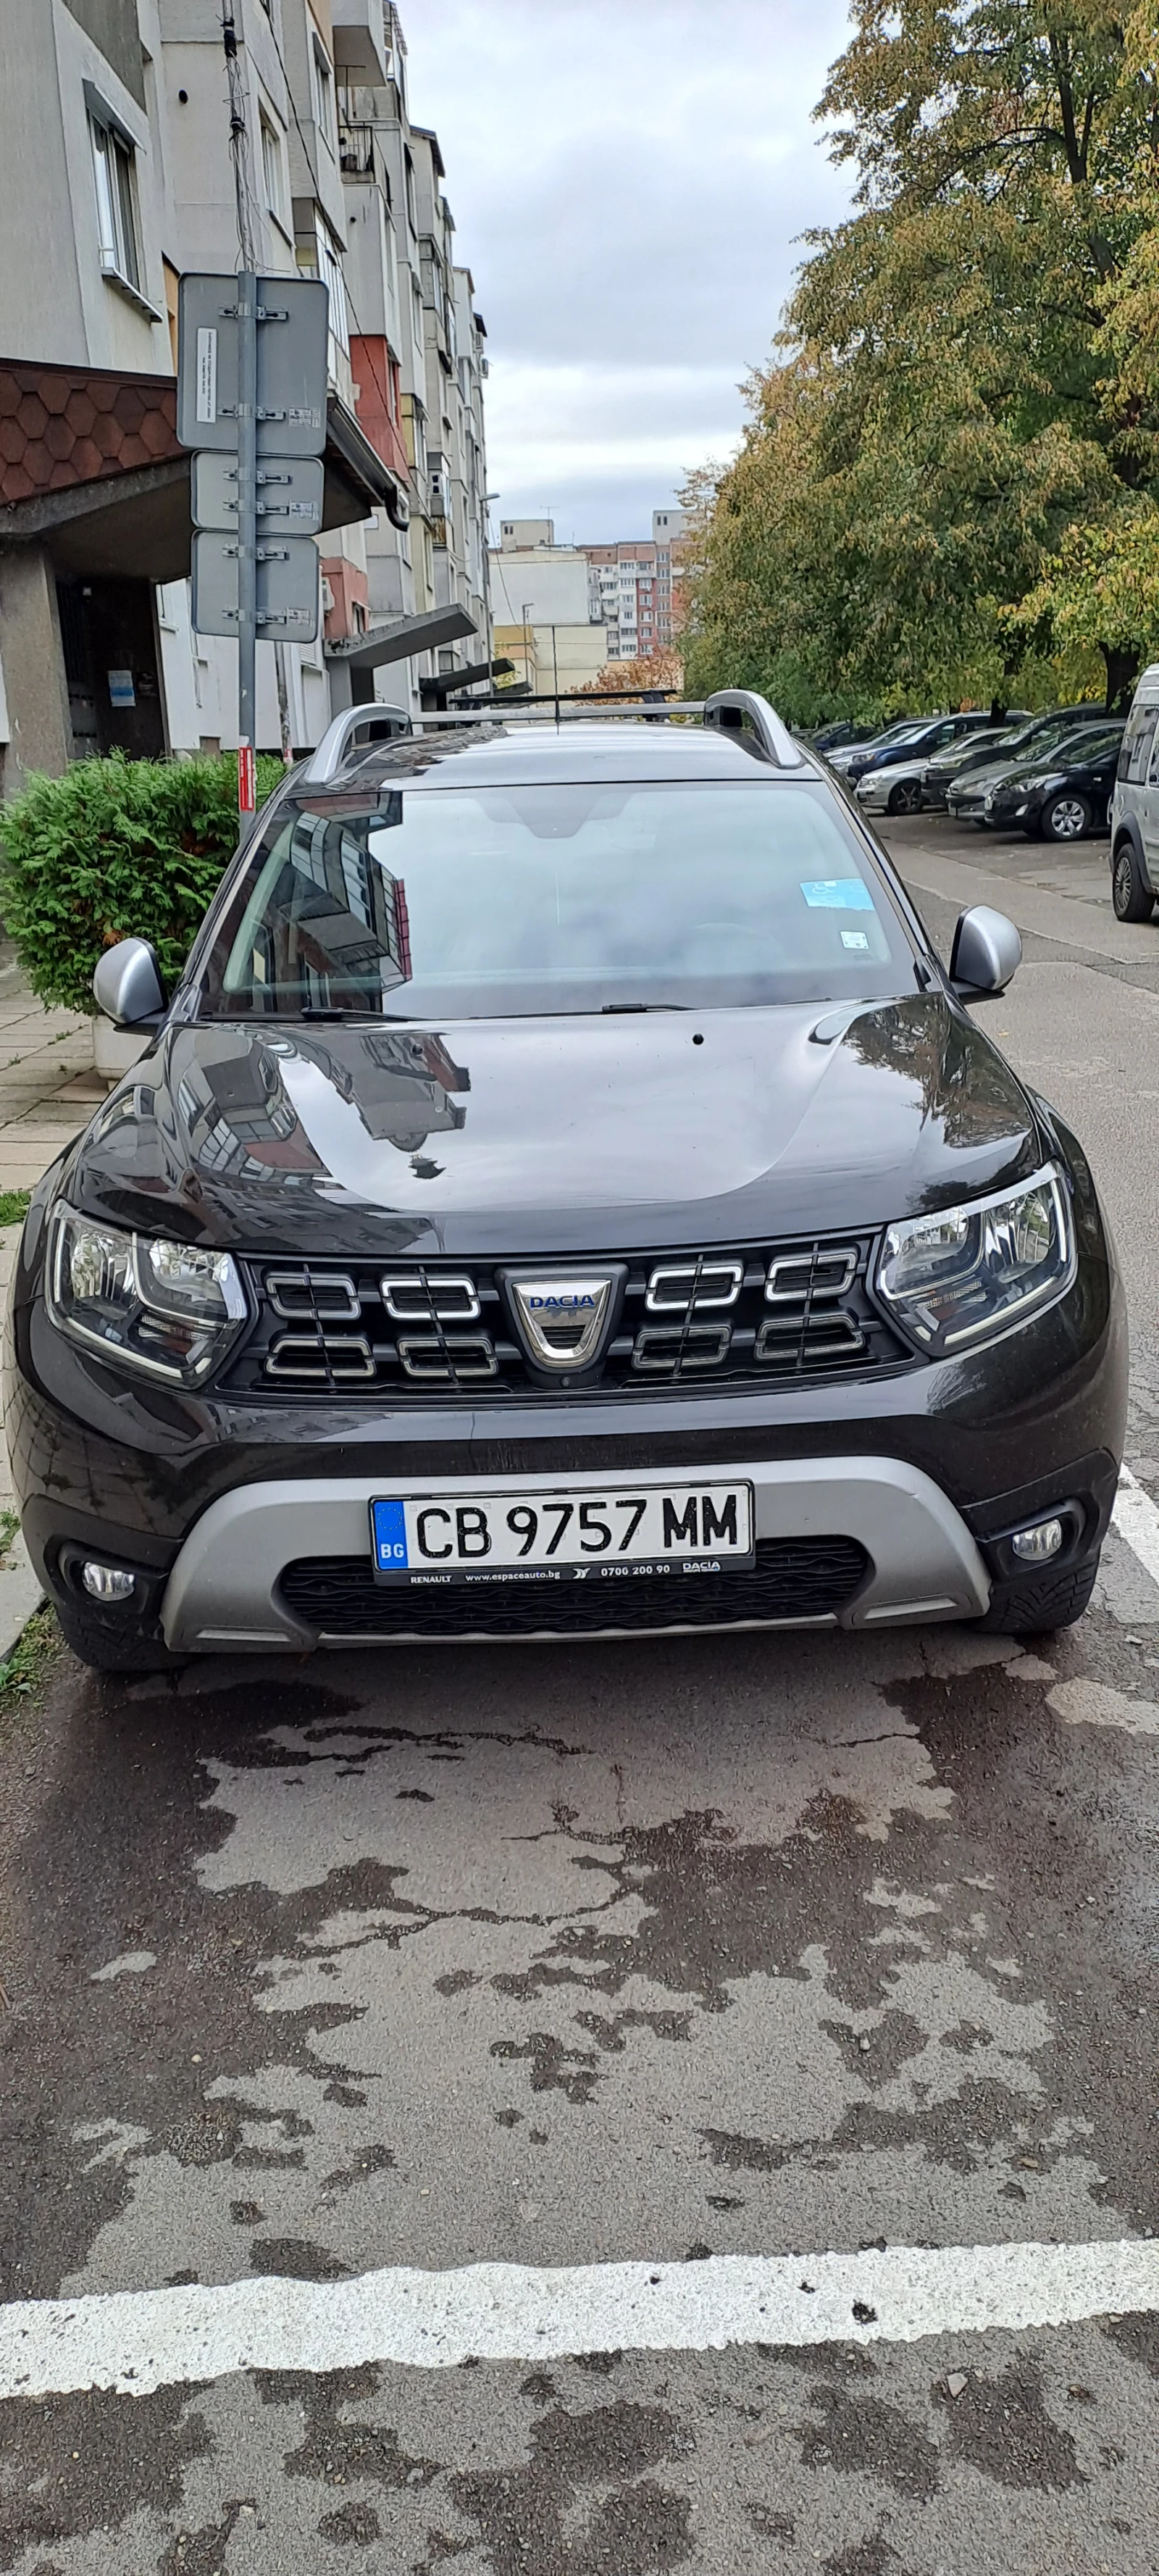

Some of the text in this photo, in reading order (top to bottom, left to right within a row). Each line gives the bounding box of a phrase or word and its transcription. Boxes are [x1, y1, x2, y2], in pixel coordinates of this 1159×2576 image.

[530, 1295, 595, 1309] DACIA
[417, 1494, 737, 1559] CB 9757 MM
[380, 1543, 404, 1559] BG
[601, 1564, 671, 1577] 0700 200 90
[682, 1561, 721, 1570] DACIA
[410, 1575, 452, 1584] RENAULT
[465, 1570, 561, 1582] www.espaceauto.bg
